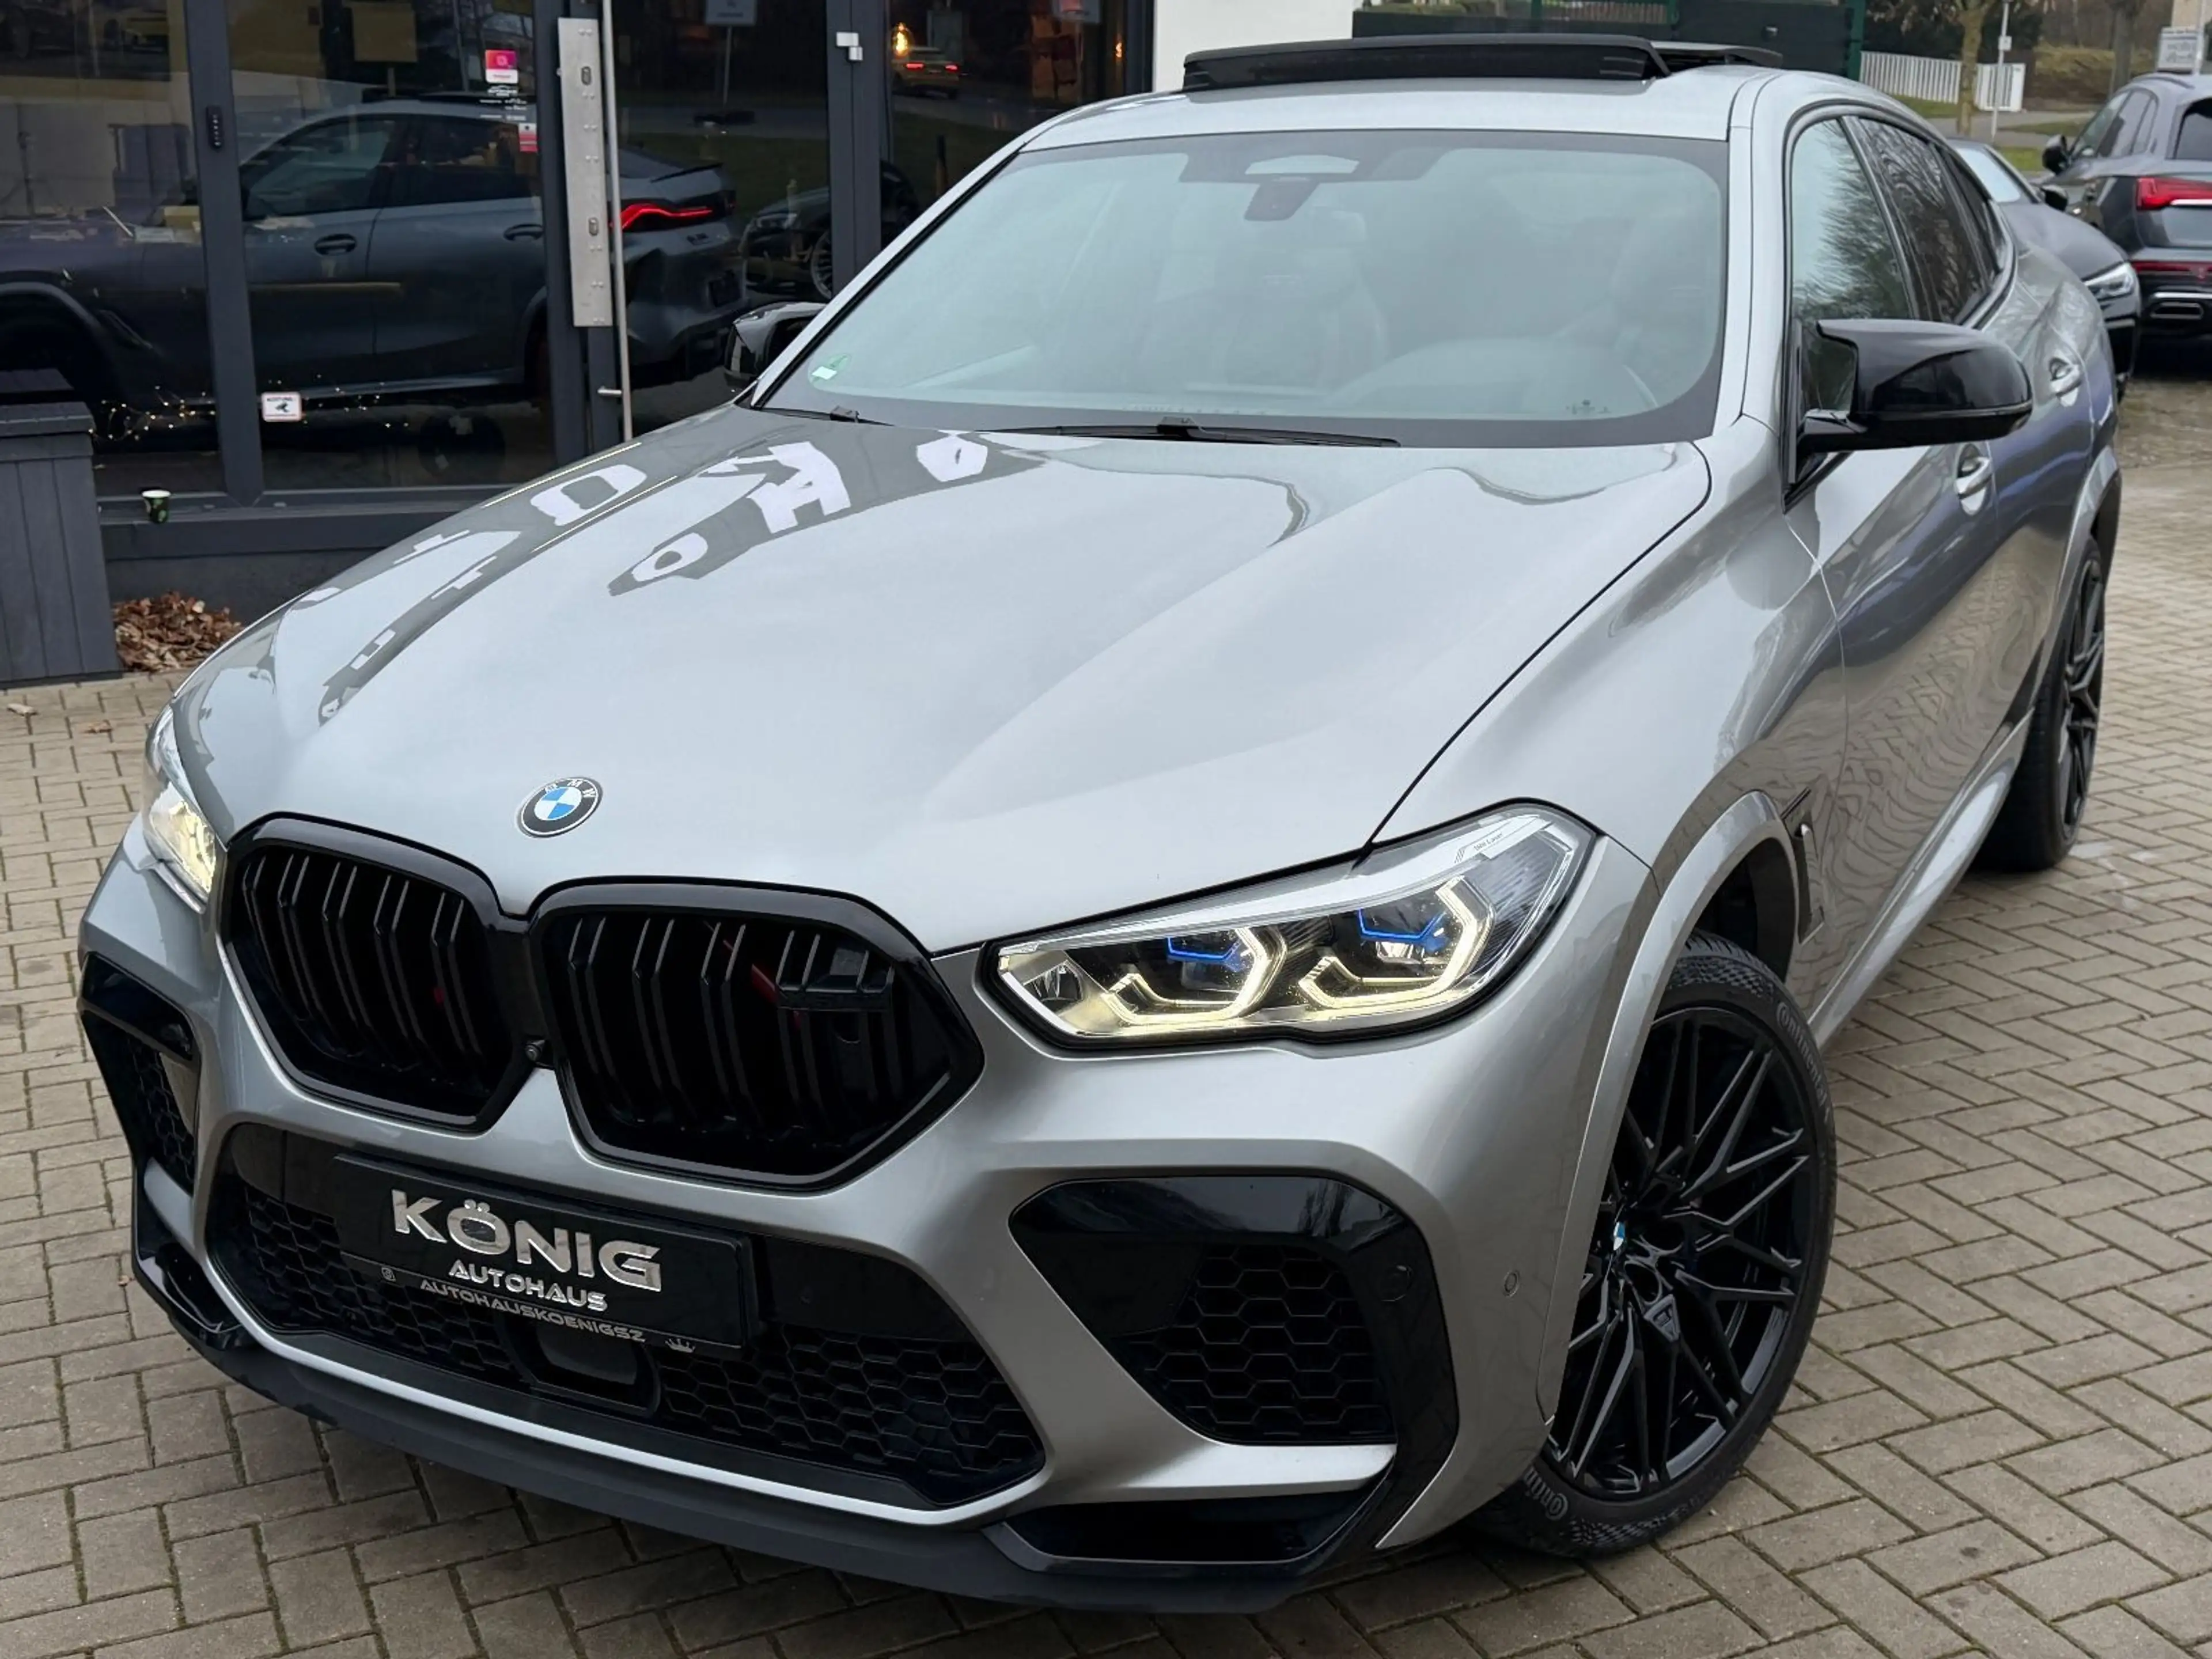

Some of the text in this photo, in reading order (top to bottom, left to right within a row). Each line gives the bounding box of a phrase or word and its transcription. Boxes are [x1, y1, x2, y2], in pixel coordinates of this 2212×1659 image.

[544, 778, 596, 798] BMW
[392, 1189, 661, 1292] KÖNIG
[420, 1279, 646, 1343] AUTOHAUSKOENIGSZ
[449, 1259, 608, 1312] AUTOHAUS
